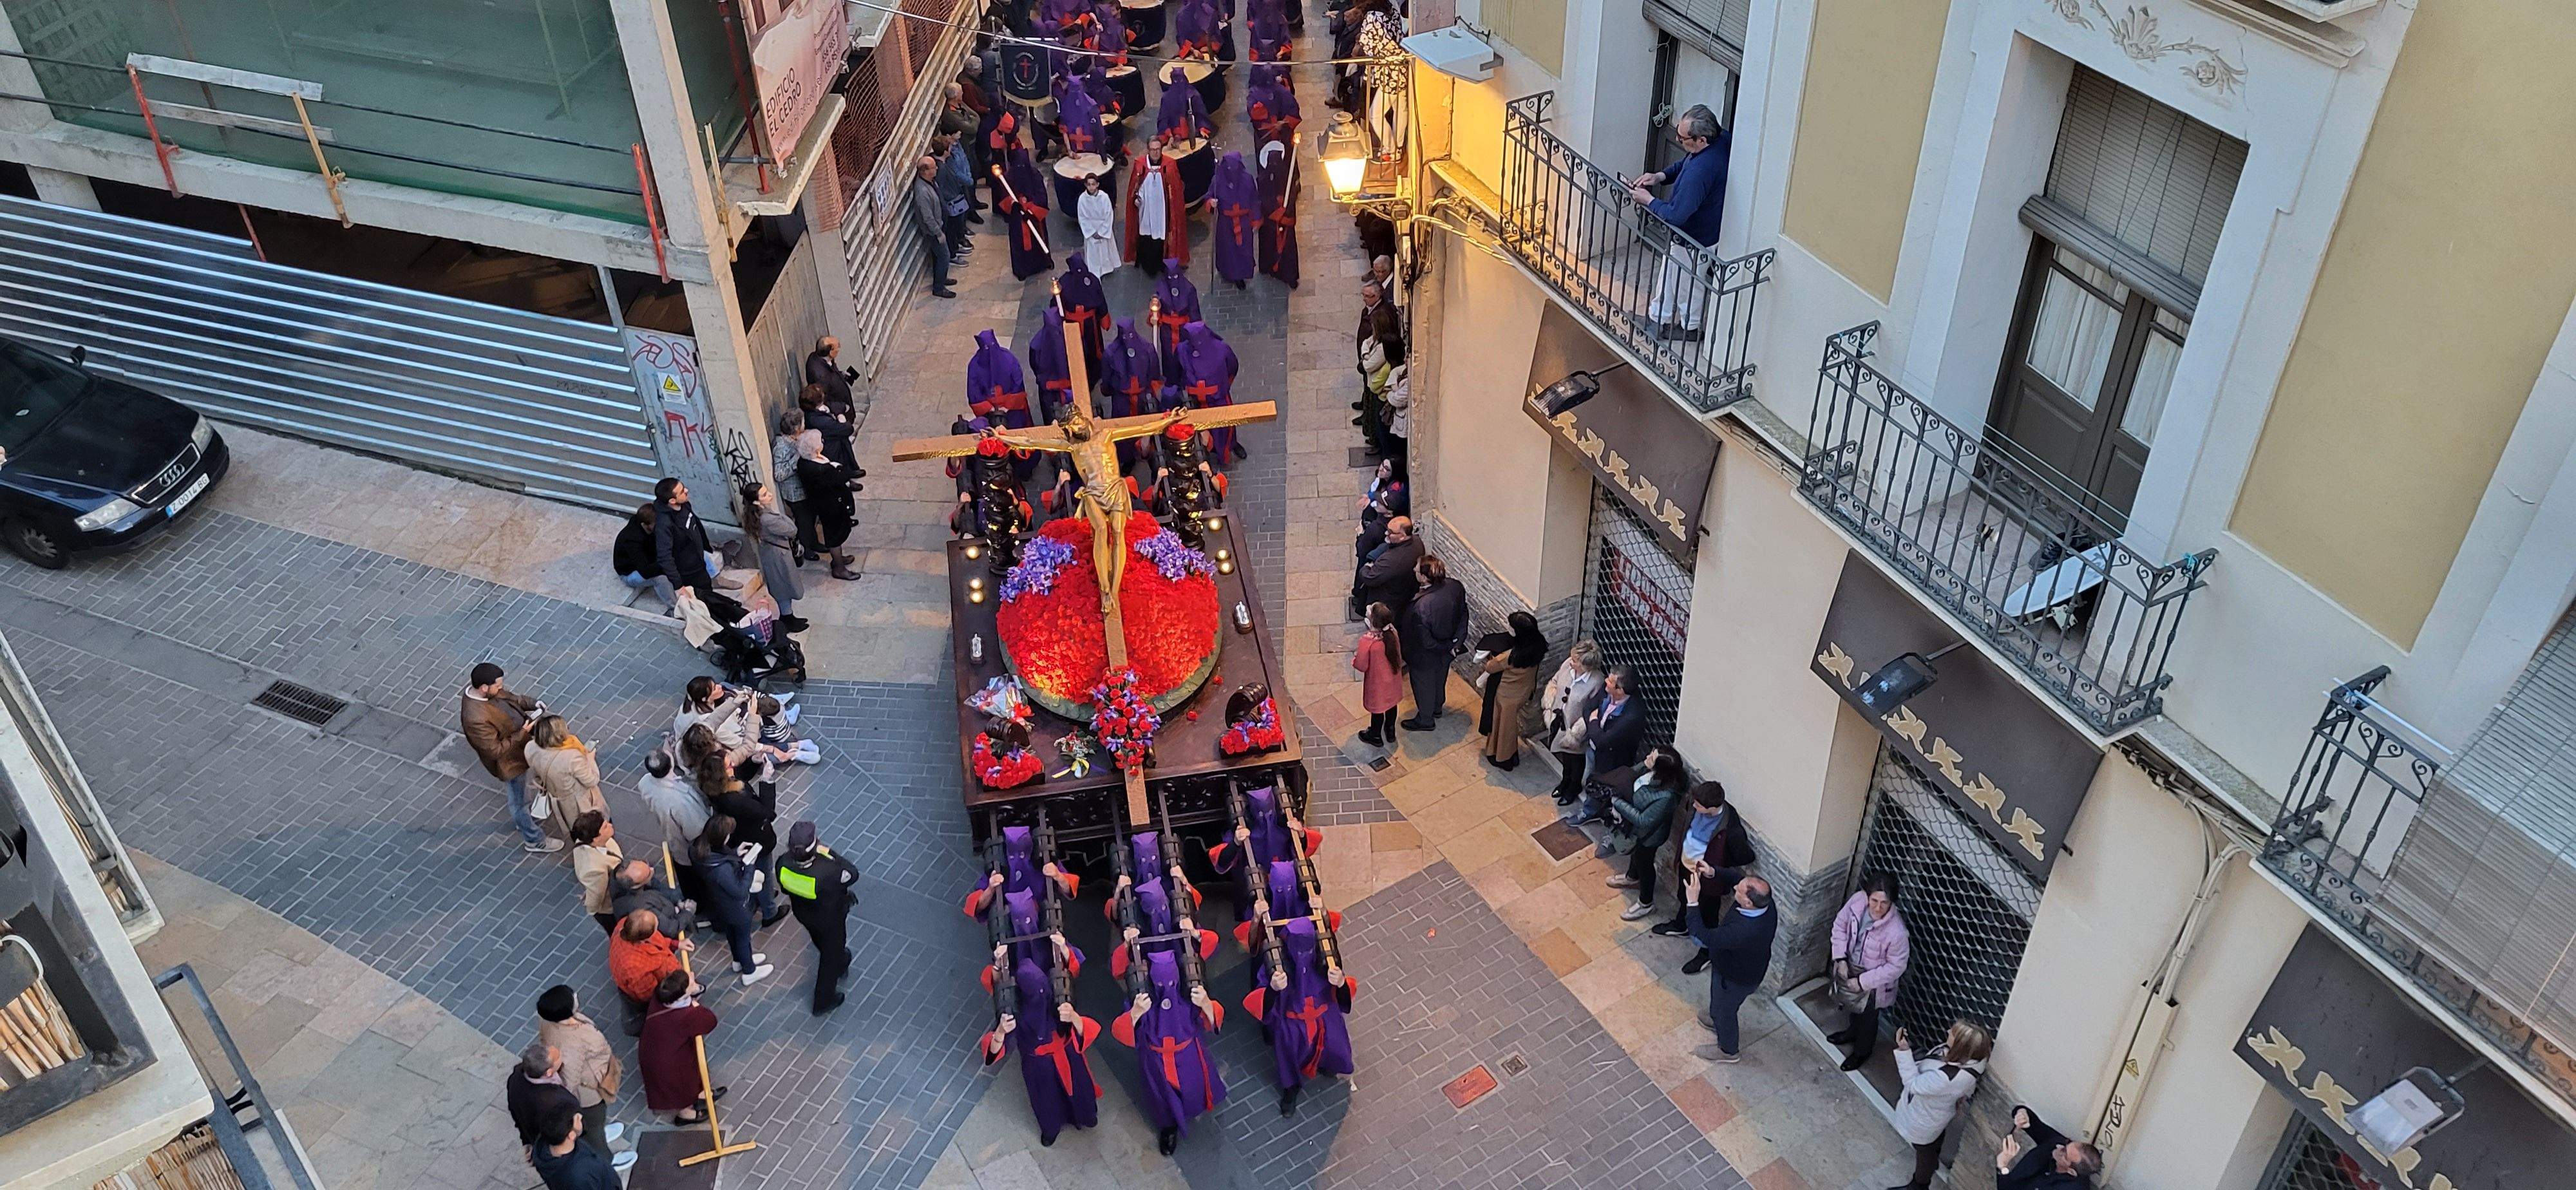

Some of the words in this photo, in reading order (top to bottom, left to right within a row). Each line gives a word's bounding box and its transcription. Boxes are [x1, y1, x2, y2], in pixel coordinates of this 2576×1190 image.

[766, 67, 795, 119] EDIFICIO
[769, 118, 779, 138] EL
[779, 81, 801, 124] CEDRO
